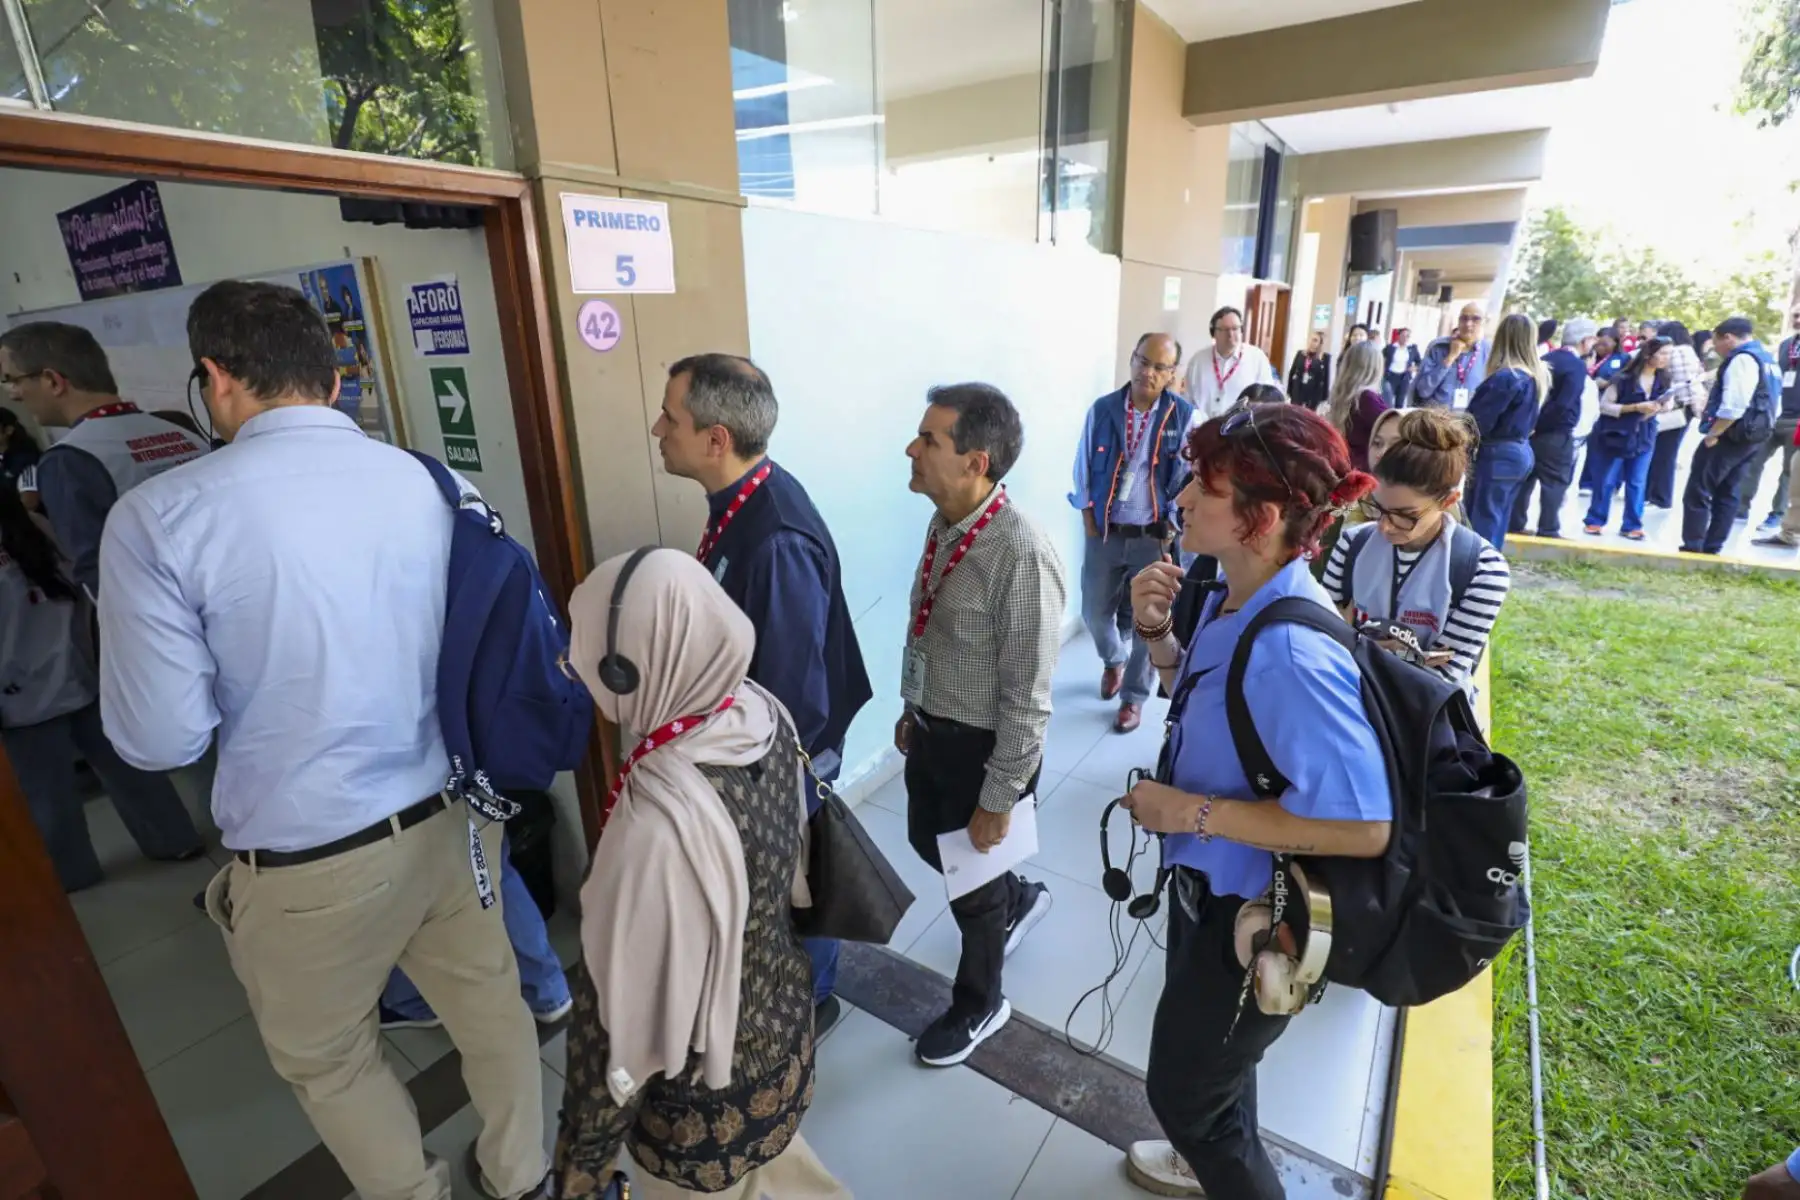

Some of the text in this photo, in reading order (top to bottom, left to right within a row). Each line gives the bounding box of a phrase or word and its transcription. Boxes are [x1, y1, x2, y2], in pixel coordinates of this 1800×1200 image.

[573, 209, 660, 232] PRIMERO
[616, 255, 636, 287] 5
[411, 286, 458, 314] AFORO
[433, 330, 466, 348] PERSONAS
[584, 311, 618, 339] 42
[447, 445, 479, 463] SALIDA
[1273, 870, 1288, 924] adidas
